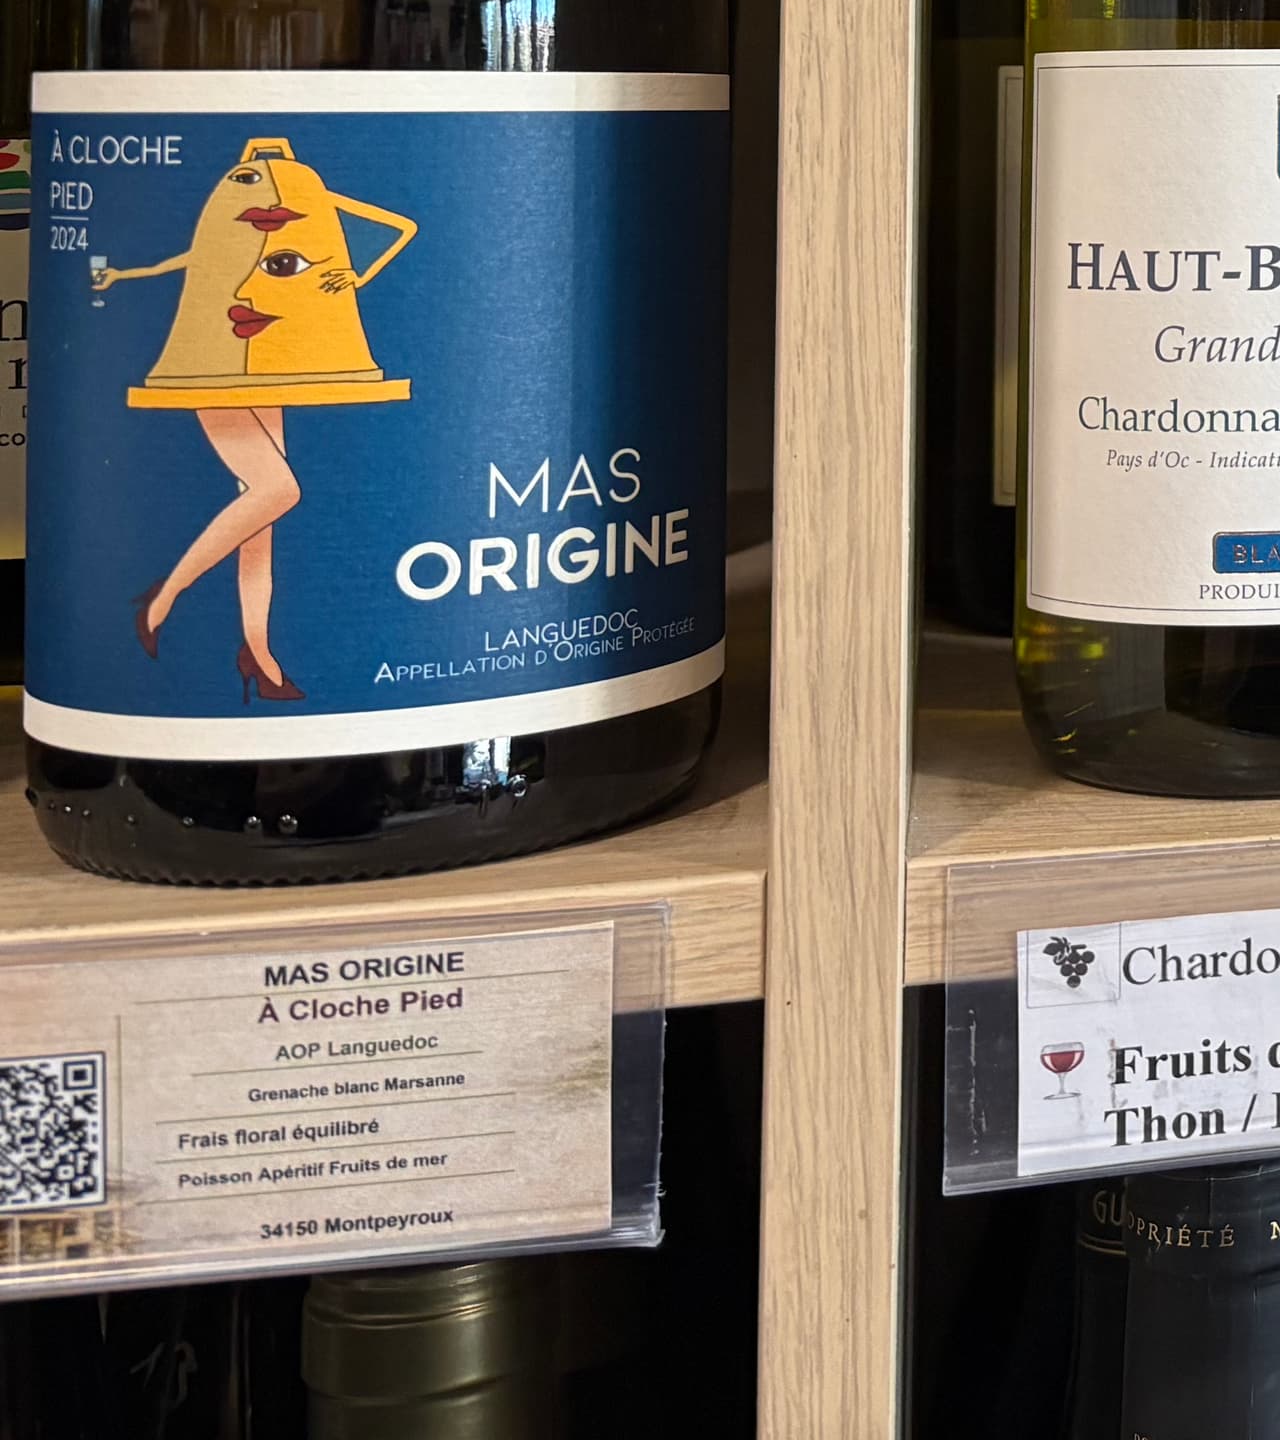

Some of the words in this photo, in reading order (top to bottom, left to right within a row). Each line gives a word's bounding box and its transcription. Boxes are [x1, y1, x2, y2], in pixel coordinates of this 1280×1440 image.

[51, 129, 64, 163] À
[69, 136, 182, 165] CLOCHE
[50, 181, 93, 211] PIED
[50, 226, 89, 251] 2024
[1106, 449, 1142, 472] Pays
[1147, 449, 1190, 469] d'Oc
[489, 448, 641, 519] MAS
[395, 508, 689, 601] ORIGINE
[484, 608, 638, 652] LANGUEDOC
[373, 652, 525, 684] APPELLATION
[264, 962, 329, 987] MAS
[339, 951, 464, 981] ORIGINE
[258, 997, 279, 1023] À
[289, 995, 390, 1020] Cloche
[400, 987, 463, 1012] Pied
[275, 1042, 321, 1061] AOP
[328, 1035, 439, 1057] Languedoc
[1112, 1037, 1252, 1085] Fruits
[248, 1085, 329, 1103] Grenache
[334, 1080, 380, 1096] blanc
[384, 1074, 465, 1091] Marsanne
[179, 1132, 228, 1150] Frais
[235, 1126, 286, 1145] floral
[292, 1118, 379, 1143] équilibré
[1104, 1100, 1227, 1148] Thon
[178, 1171, 252, 1188] Poisson
[258, 1163, 324, 1183] Apéritif
[329, 1157, 381, 1176] Fruits
[386, 1155, 408, 1170] de
[413, 1153, 448, 1167] mer
[260, 1220, 318, 1239] 34150
[324, 1210, 453, 1235] Montpeyroux
